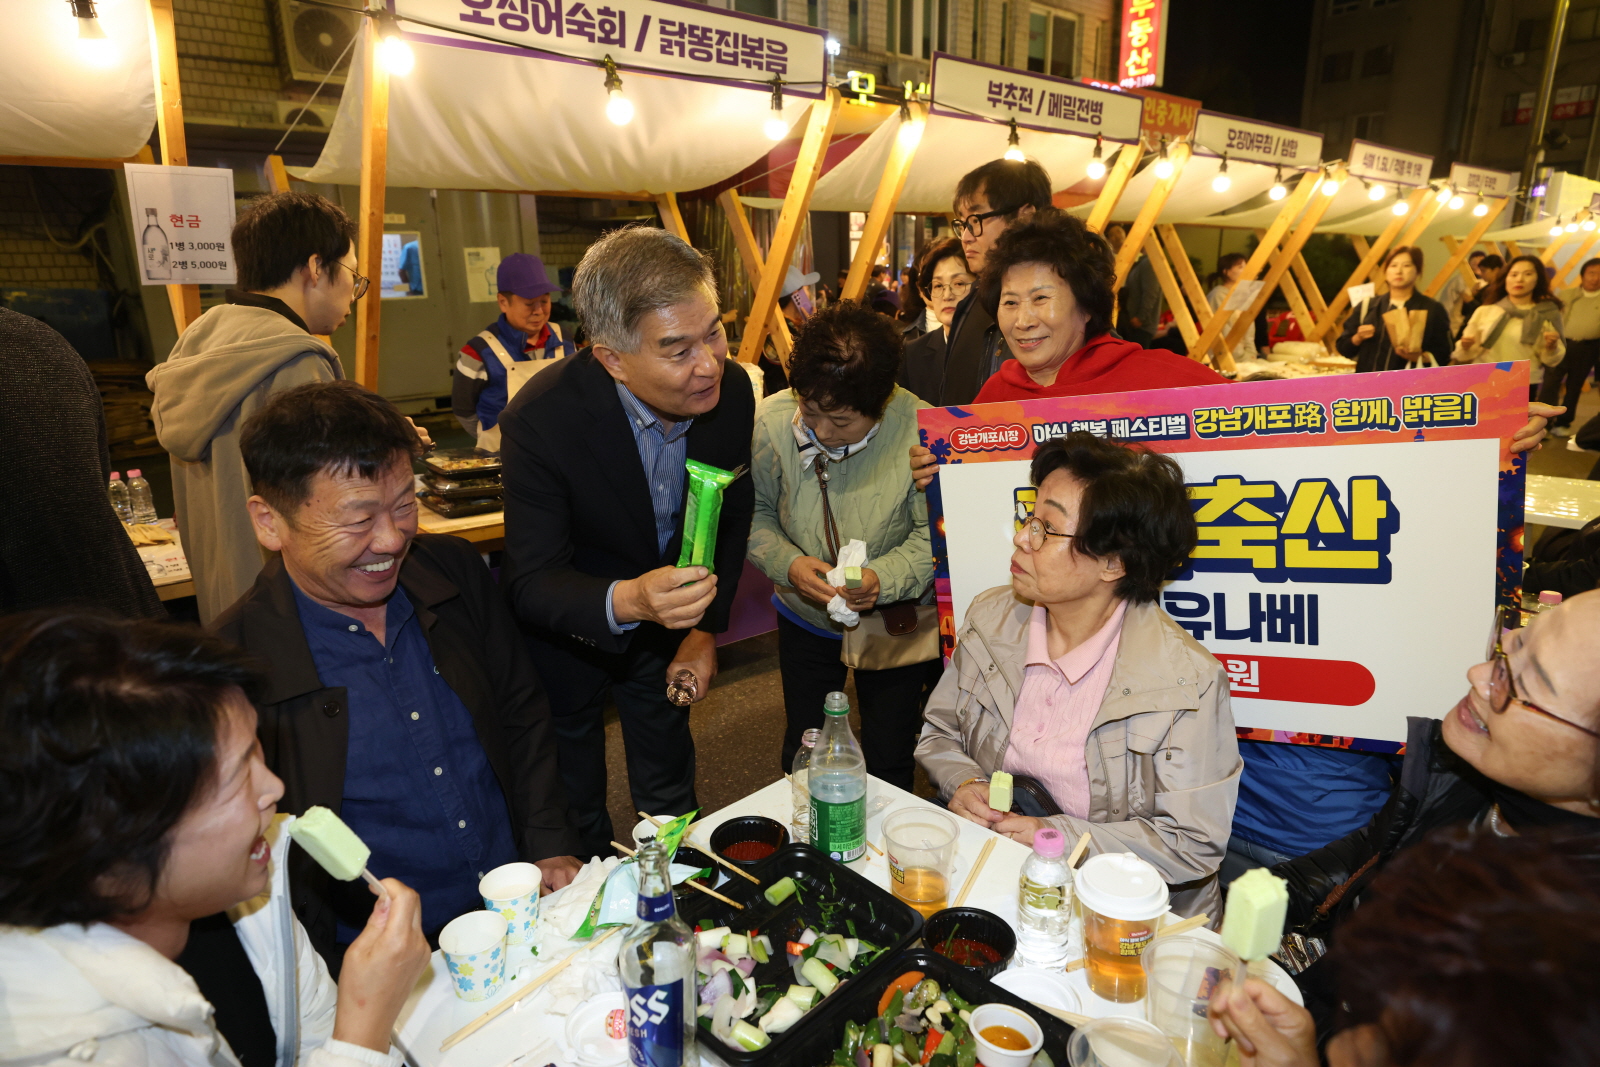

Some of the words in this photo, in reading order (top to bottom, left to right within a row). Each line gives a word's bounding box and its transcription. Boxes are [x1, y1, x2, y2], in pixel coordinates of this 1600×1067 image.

[459, 0, 626, 48] 오징어숙회
[635, 15, 651, 52] /
[658, 18, 789, 74] 닭똥집볶음
[987, 80, 1033, 113] 부추전
[1035, 90, 1046, 116] /
[1048, 92, 1104, 125] 메밀전병
[1226, 128, 1273, 154] 오징어무침
[169, 214, 201, 228] 현금
[169, 242, 185, 251] 1병
[188, 242, 225, 251] 3,000원
[172, 261, 188, 269] 2병
[191, 261, 227, 270] 5,000원
[957, 429, 1019, 446] 강남개포시장
[1111, 415, 1187, 437] 페스티벌
[1194, 403, 1324, 433] 강남개포路
[1332, 398, 1397, 427] 함께,
[1402, 394, 1473, 422] 밝음!
[1156, 590, 1319, 645] 유나베
[630, 989, 670, 1028] SS
[630, 1028, 648, 1038] ESH
